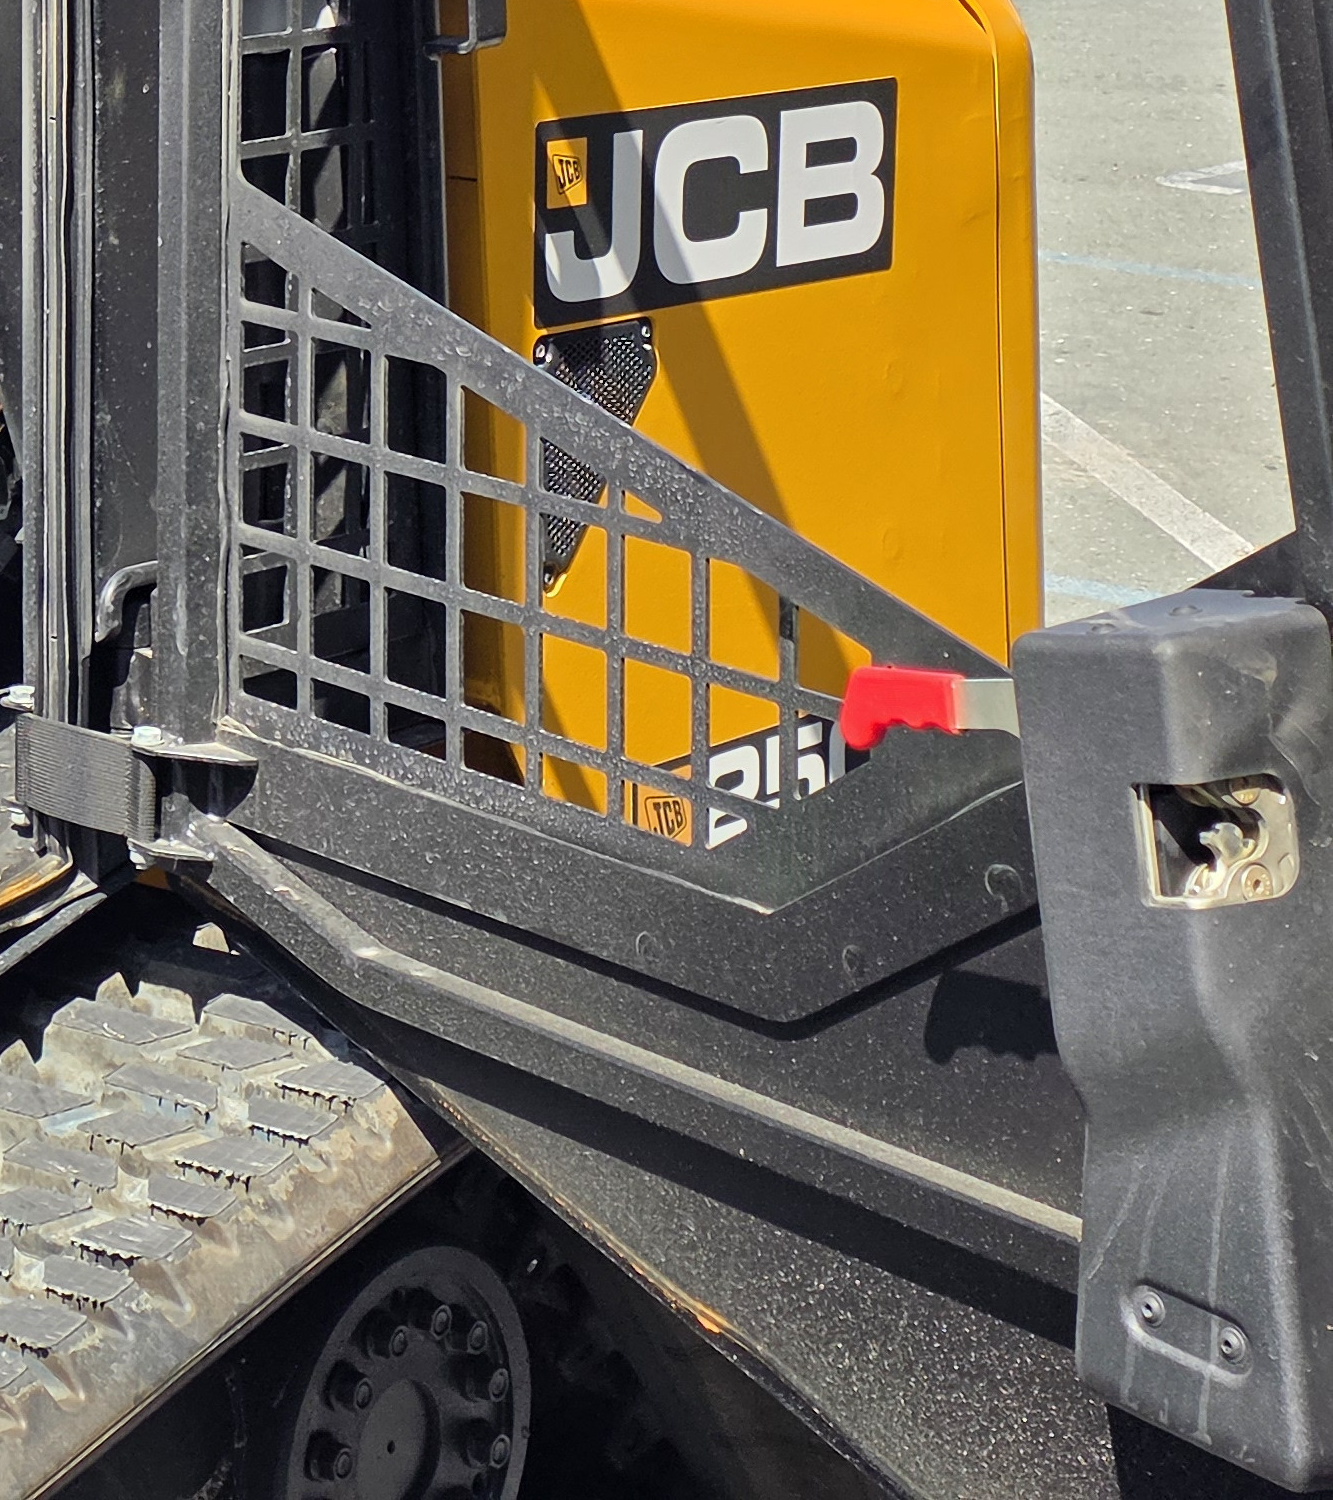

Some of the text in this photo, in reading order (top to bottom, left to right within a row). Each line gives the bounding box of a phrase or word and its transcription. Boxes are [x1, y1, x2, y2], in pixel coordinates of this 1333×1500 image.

[556, 156, 582, 187] JCB
[545, 100, 885, 303] JCB
[652, 797, 684, 837] JCB
